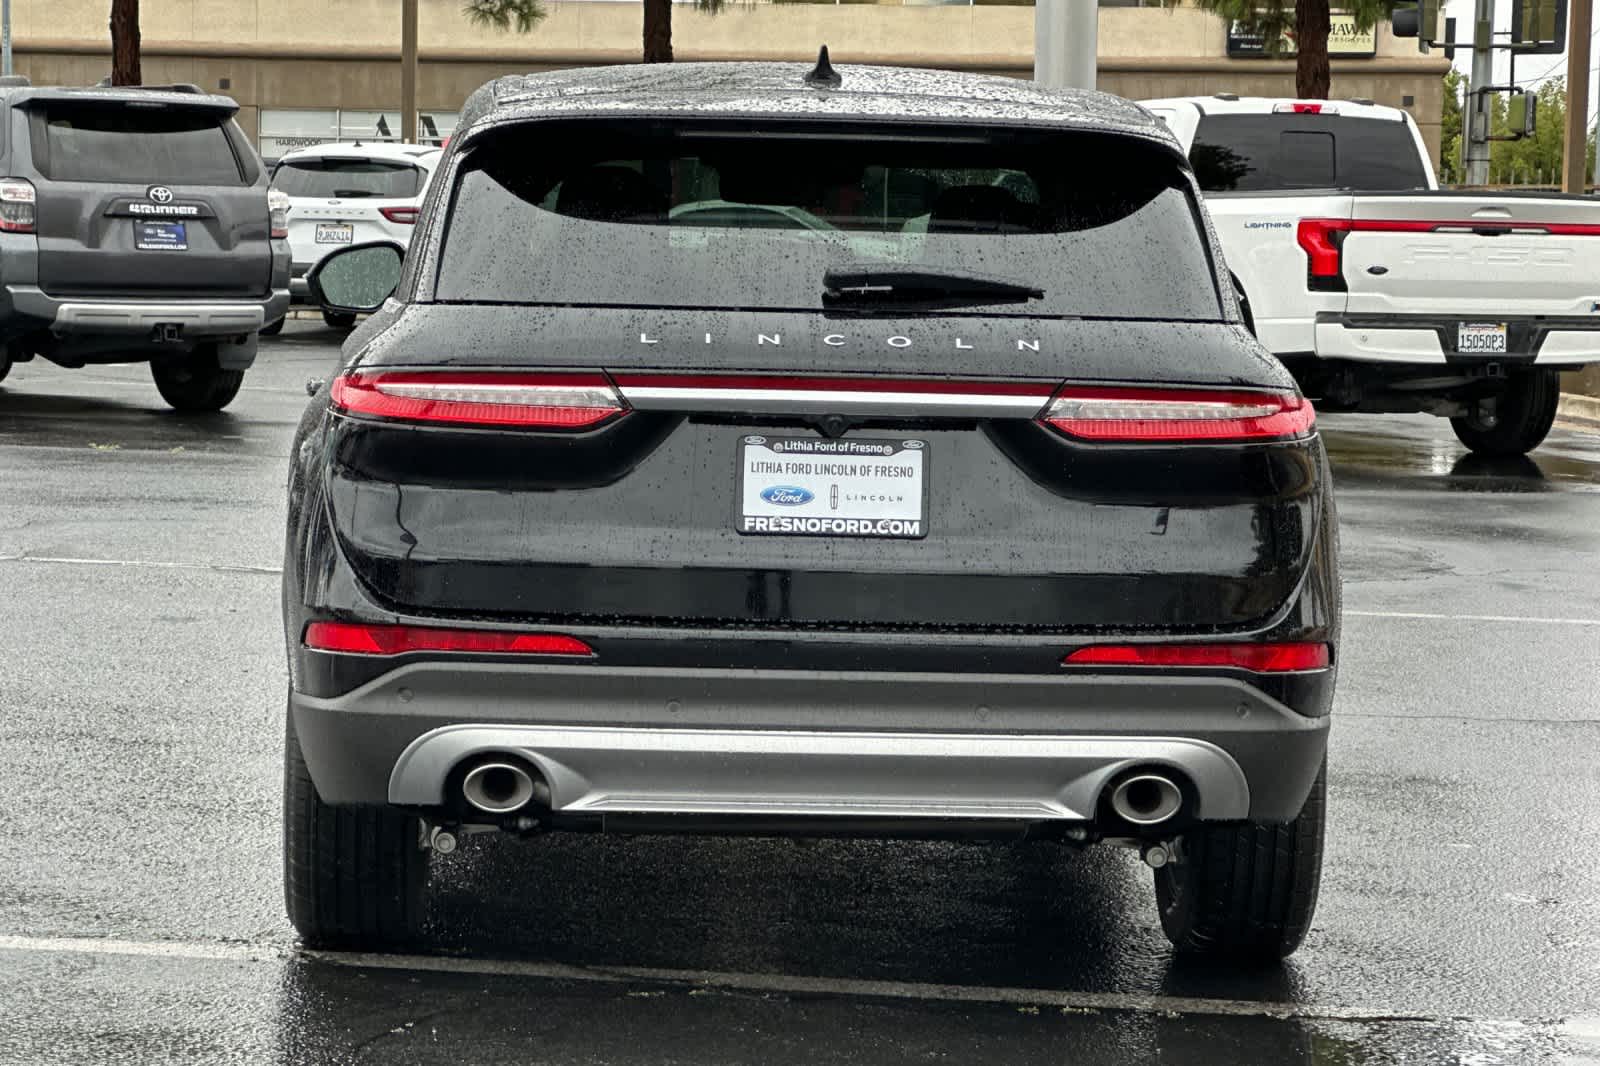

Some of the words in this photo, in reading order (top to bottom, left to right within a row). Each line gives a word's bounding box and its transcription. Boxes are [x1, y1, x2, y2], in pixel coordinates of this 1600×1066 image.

[640, 332, 1041, 352] LINCOLN
[784, 441, 813, 451] Lithia
[814, 442, 837, 452] Ford
[838, 442, 849, 452] of
[850, 443, 883, 453] Fresno
[751, 461, 783, 474] LITHIA
[785, 463, 812, 475] FORD
[814, 464, 857, 476] LINCOLN
[860, 465, 873, 477] OF
[875, 466, 914, 478] FRESNO
[770, 488, 804, 504] Ford
[846, 494, 903, 502] LINCOLN
[744, 517, 920, 535] FRESNOFORD.COM
